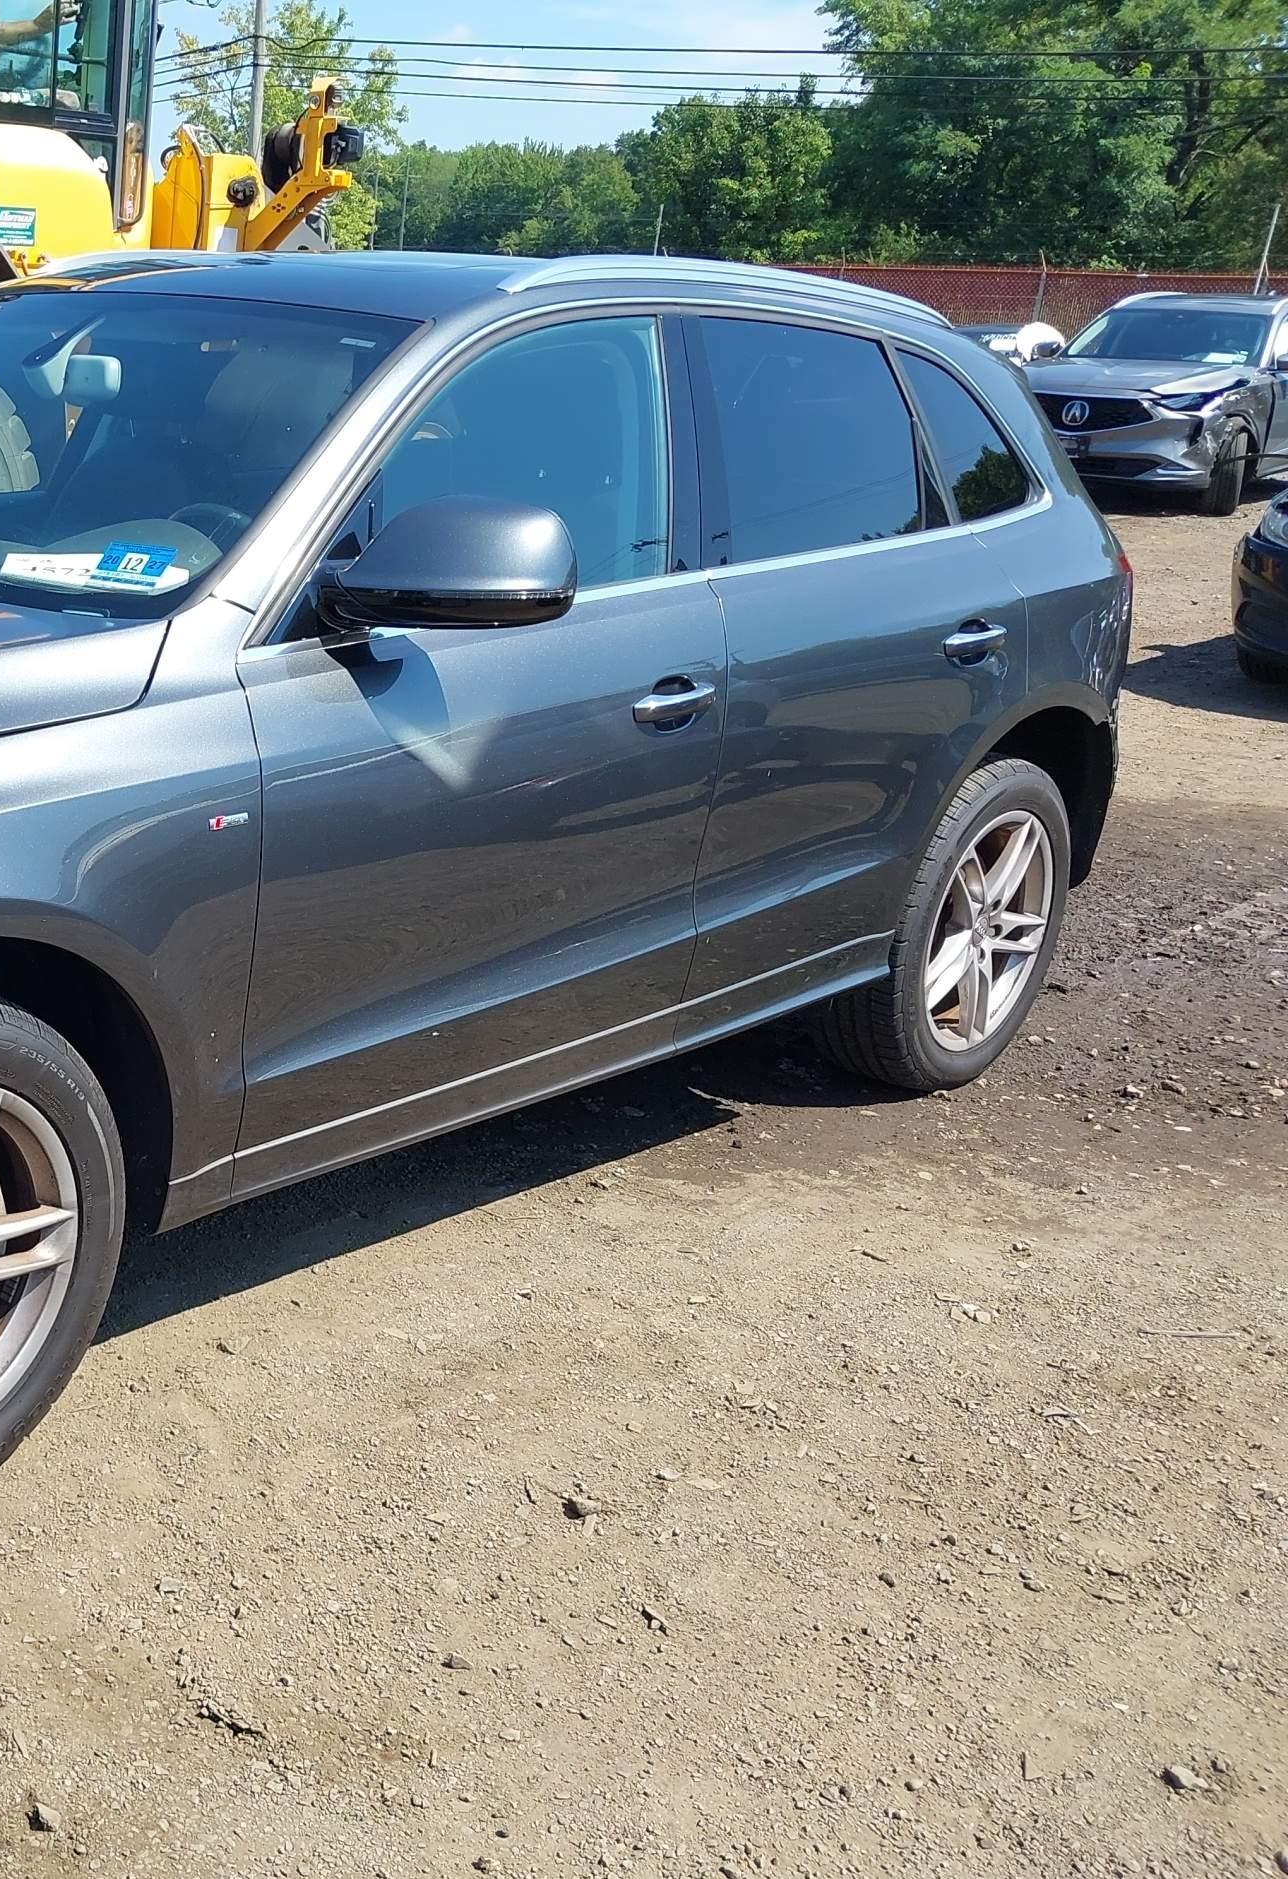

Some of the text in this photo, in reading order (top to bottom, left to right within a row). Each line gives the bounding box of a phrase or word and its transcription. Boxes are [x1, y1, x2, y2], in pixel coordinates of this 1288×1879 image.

[103, 555, 167, 572] 20 12 27
[19, 1046, 67, 1079] 235/55
[66, 1078, 86, 1101] R19
